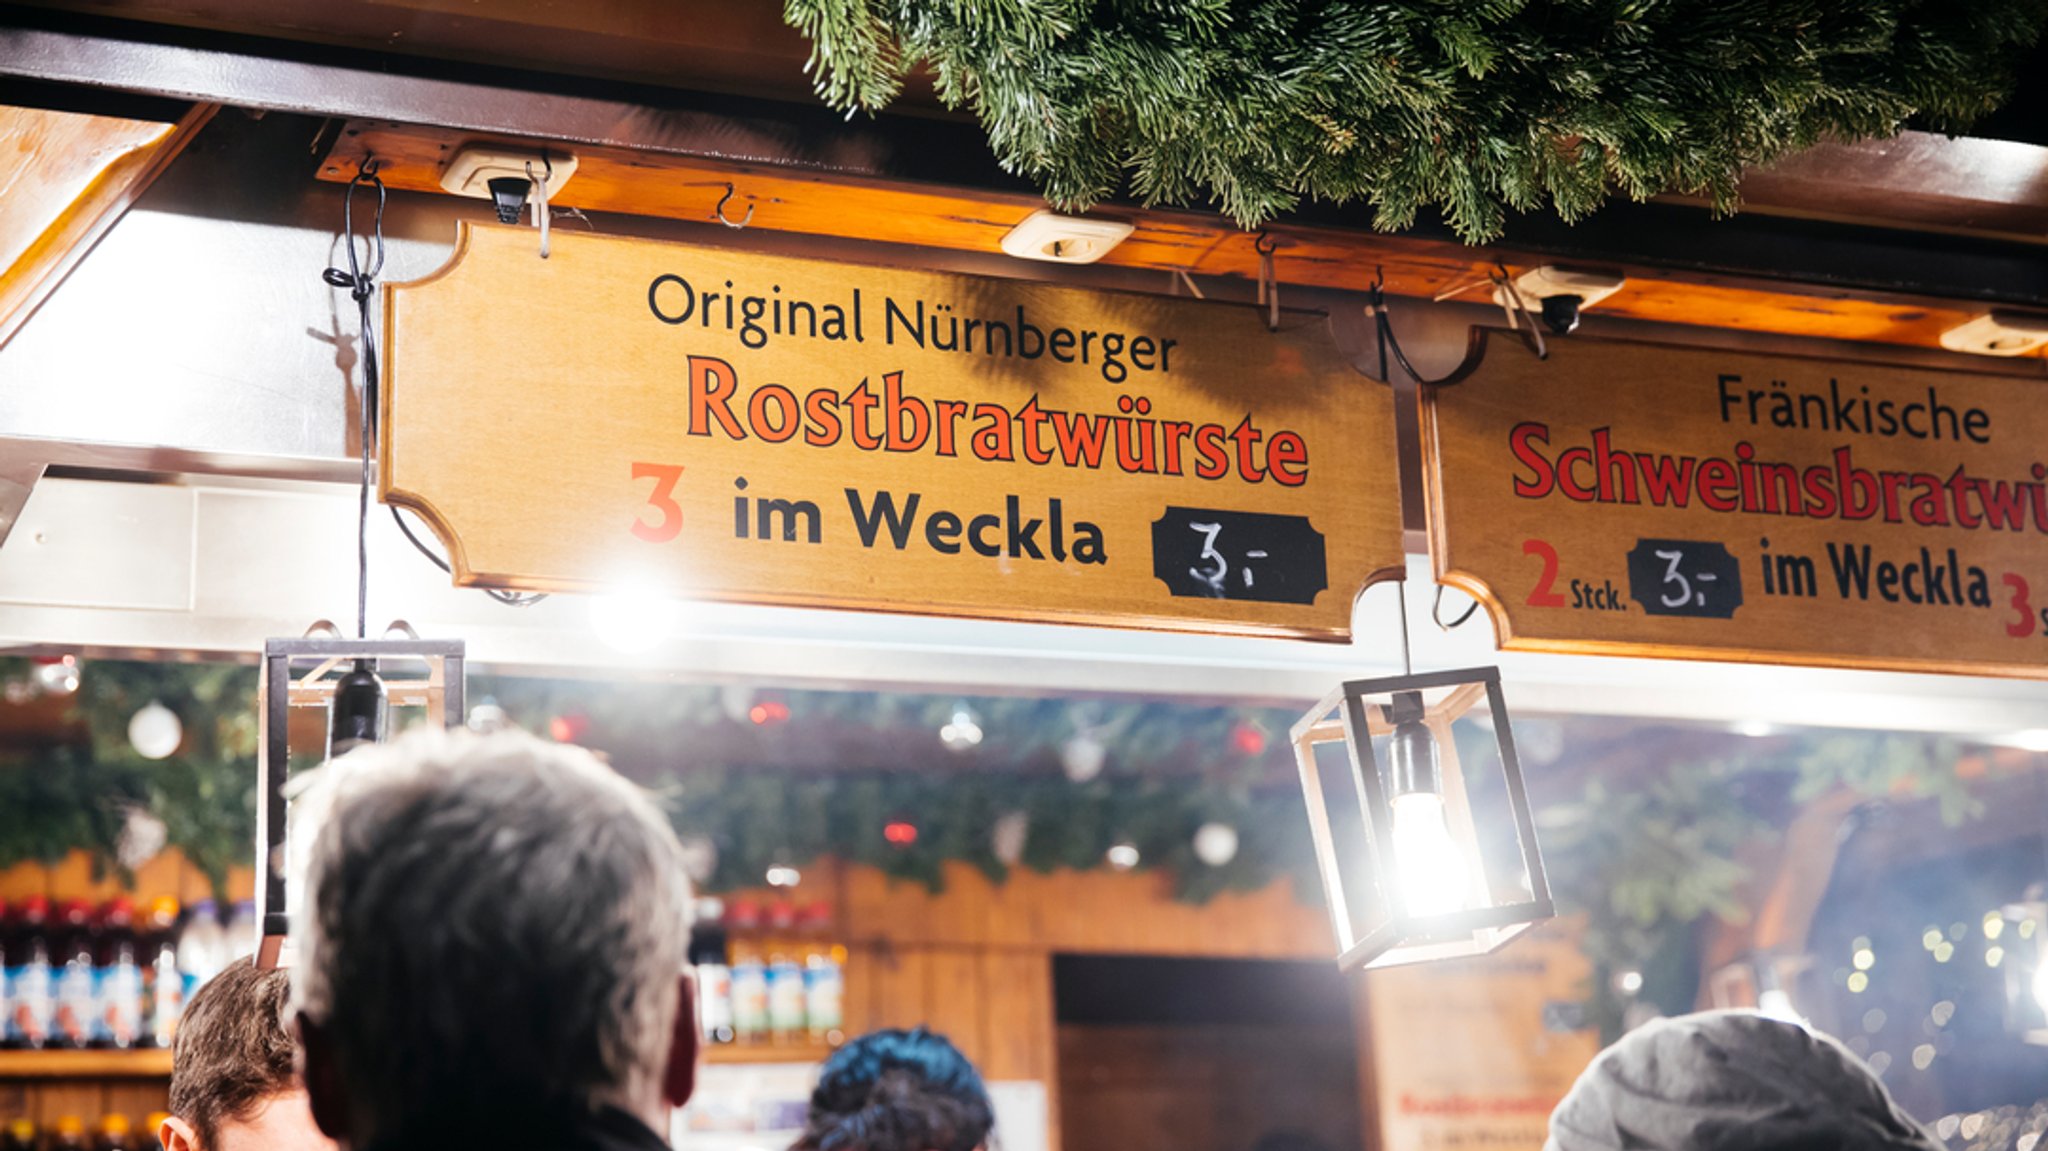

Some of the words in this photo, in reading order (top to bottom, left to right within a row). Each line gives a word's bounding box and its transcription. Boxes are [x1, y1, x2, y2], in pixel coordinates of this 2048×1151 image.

[648, 273, 864, 350] Original
[885, 297, 1177, 384] Nürnberger
[686, 354, 1309, 487] Rostbratwürste
[1717, 374, 1991, 443] Fränkische
[630, 462, 684, 543] 3
[734, 476, 822, 545] im
[844, 487, 1108, 566] Weckla
[1522, 539, 1566, 608] 2
[1570, 578, 1628, 612] Stck.
[1760, 537, 1818, 597] im
[1826, 542, 1992, 609] Weckla
[2002, 572, 2036, 638] 3
